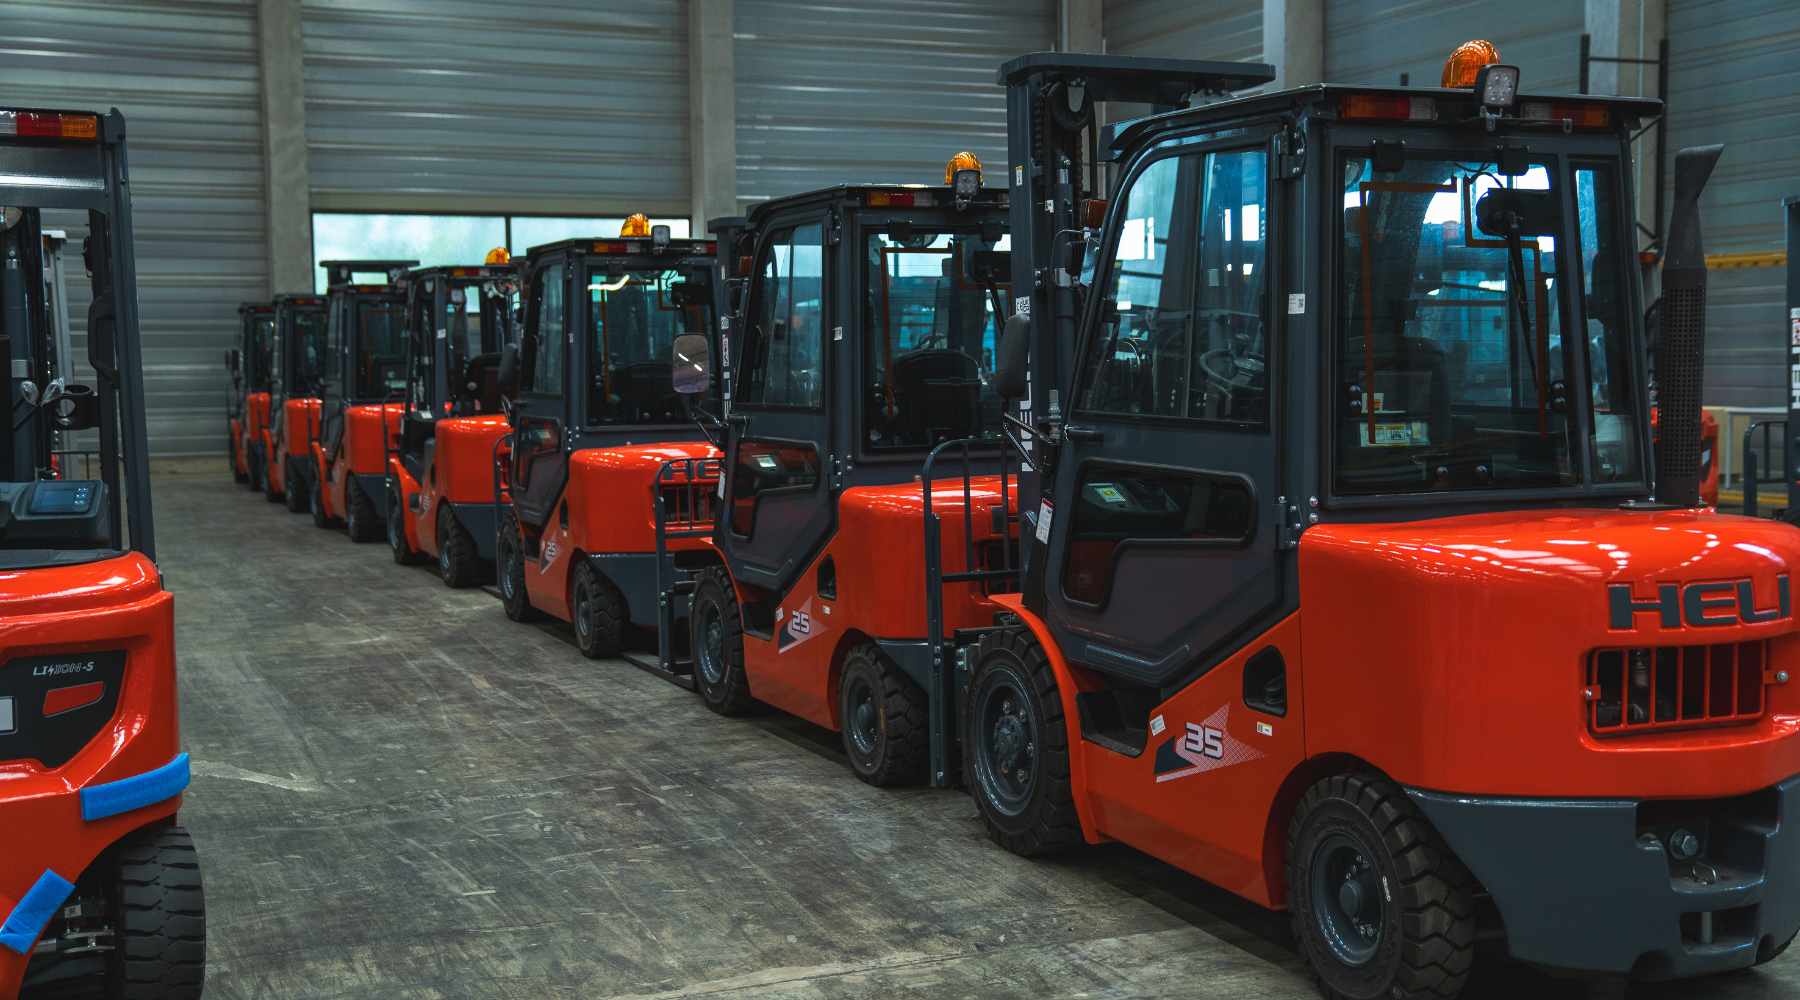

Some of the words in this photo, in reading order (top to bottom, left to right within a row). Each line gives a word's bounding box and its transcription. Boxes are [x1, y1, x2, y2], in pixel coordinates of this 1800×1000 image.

[1608, 575, 1791, 629] HELI
[792, 610, 810, 634] 25
[1185, 721, 1224, 760] 35
